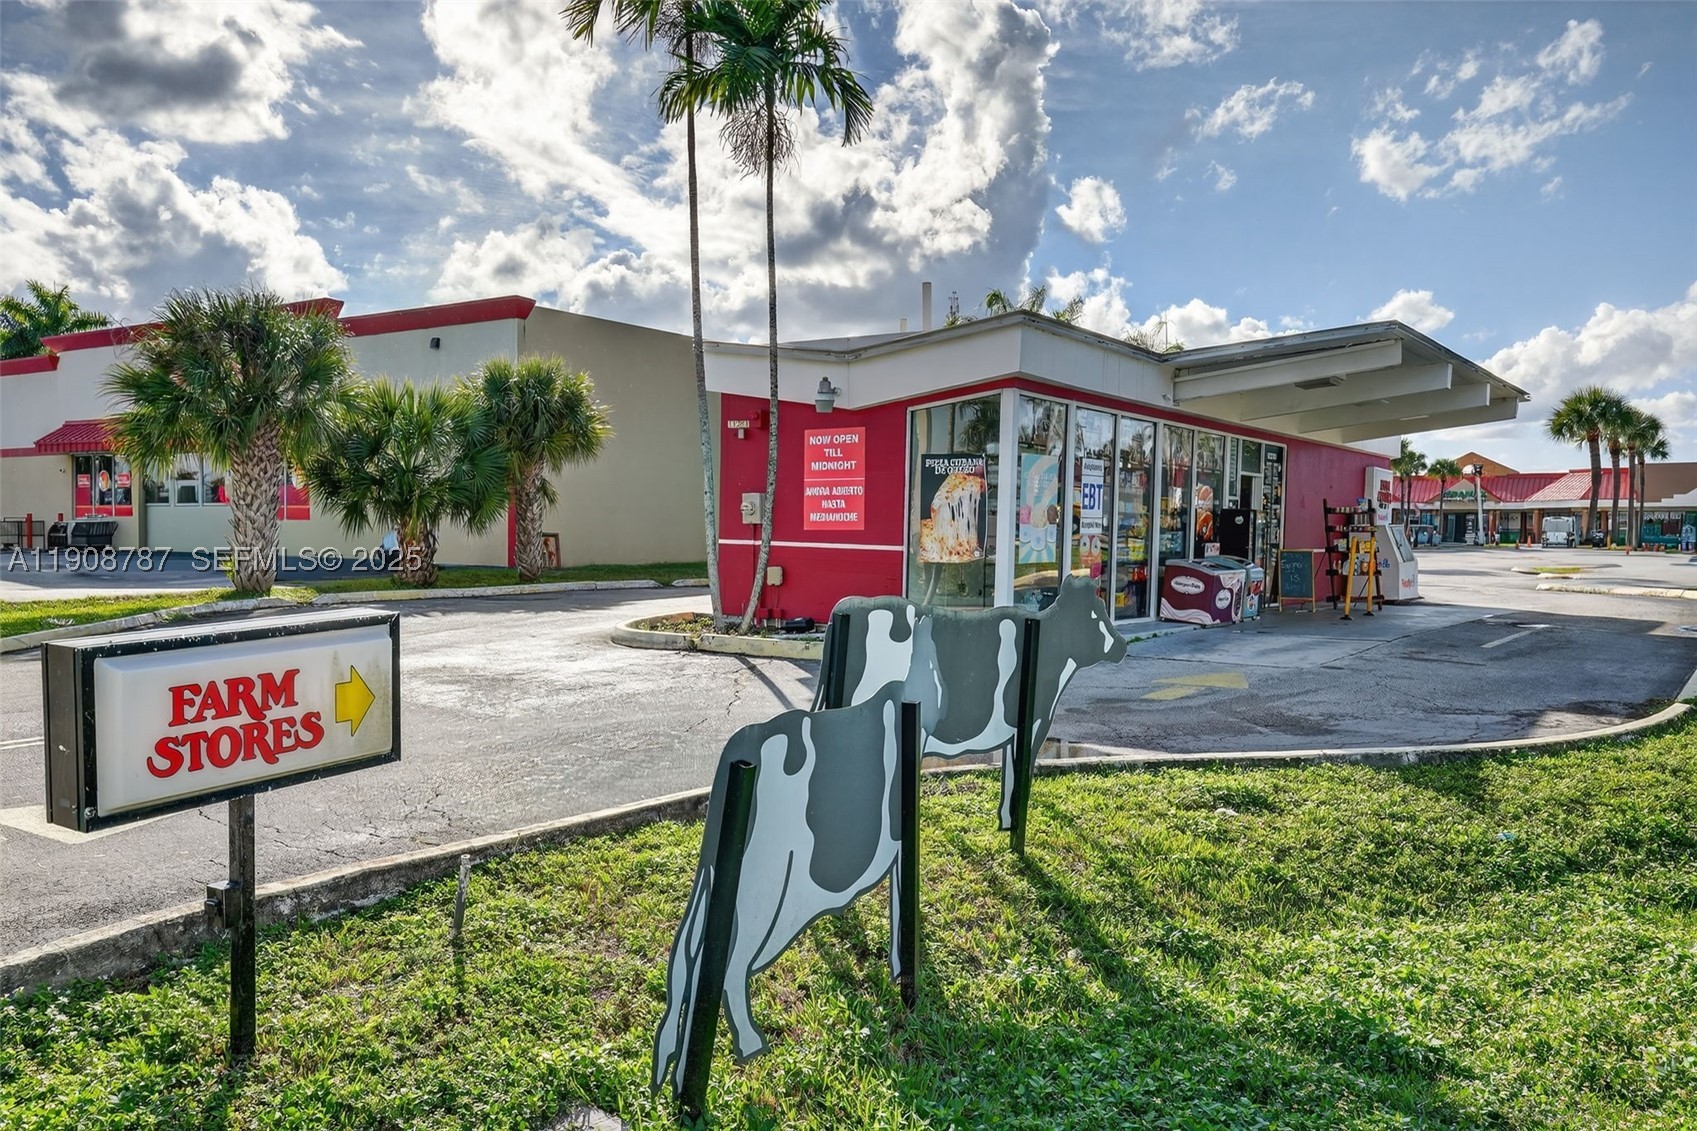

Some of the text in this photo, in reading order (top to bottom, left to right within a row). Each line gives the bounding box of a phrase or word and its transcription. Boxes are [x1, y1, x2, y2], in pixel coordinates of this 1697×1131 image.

[809, 434, 859, 445] NOW OPEN
[824, 448, 843, 457] TILL
[811, 461, 857, 471] MIDNIGHT
[1082, 482, 1103, 510] EBT
[168, 668, 300, 727] FARM
[147, 711, 325, 778] STORES
